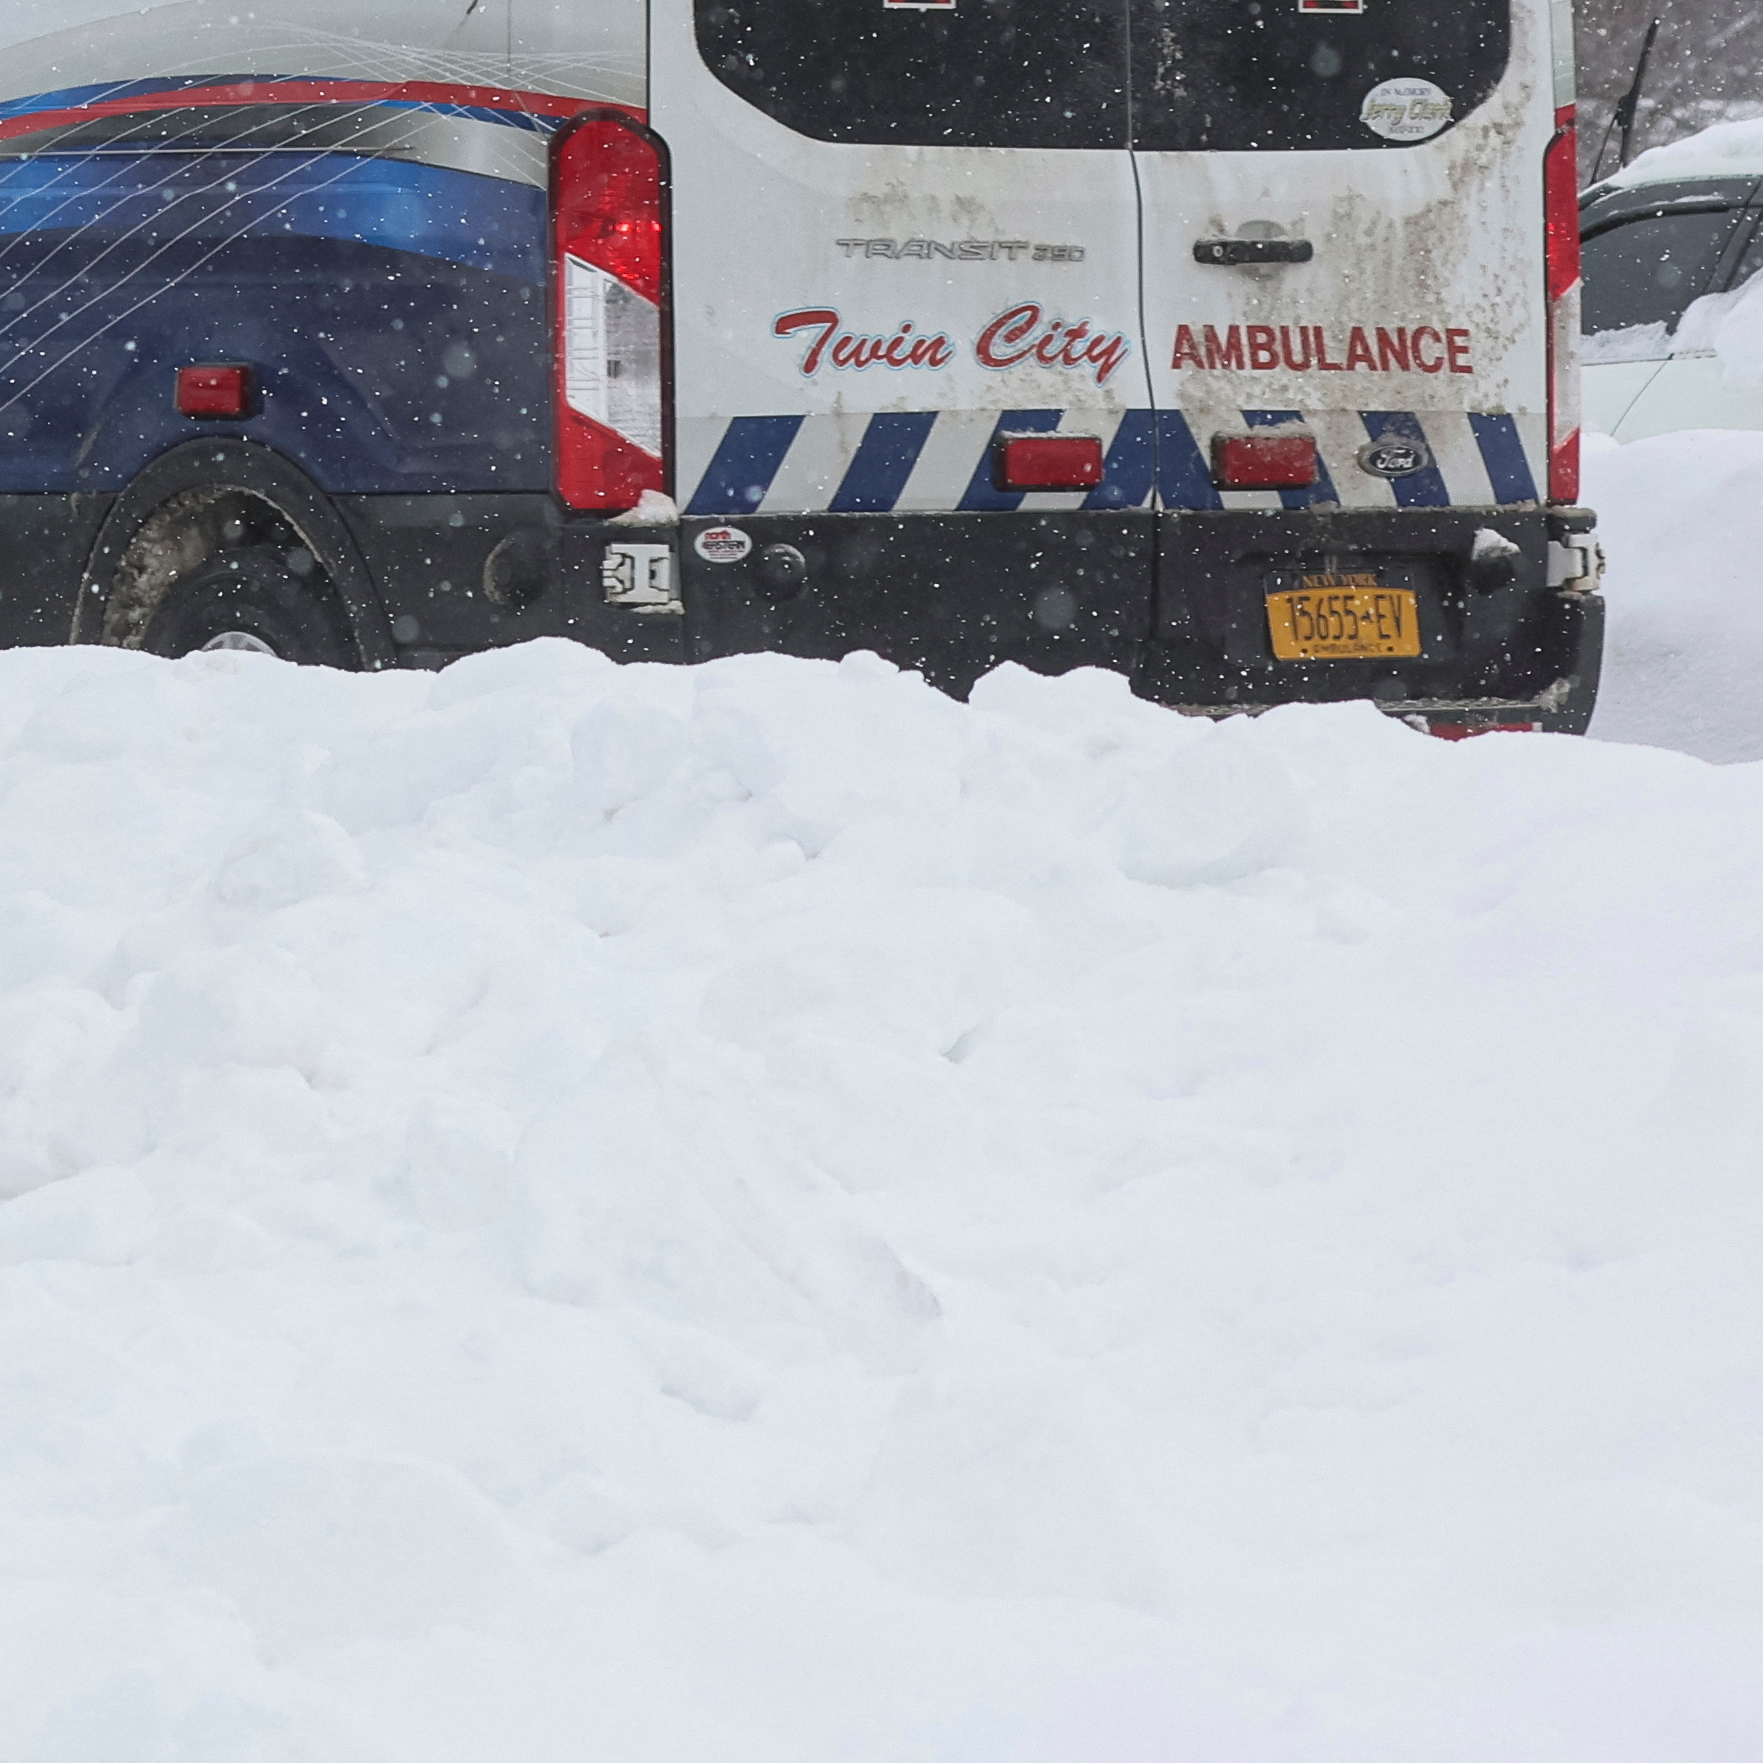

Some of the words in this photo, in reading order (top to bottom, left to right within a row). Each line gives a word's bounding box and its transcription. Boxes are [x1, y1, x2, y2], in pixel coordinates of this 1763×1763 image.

[836, 237, 1029, 262] TRANSIT
[773, 308, 953, 376] Twin
[975, 303, 1130, 385] City
[1171, 324, 1474, 374] AMBULANCE
[1376, 448, 1415, 469] Ford
[1303, 574, 1336, 588] NEW
[1340, 573, 1377, 587] YORK
